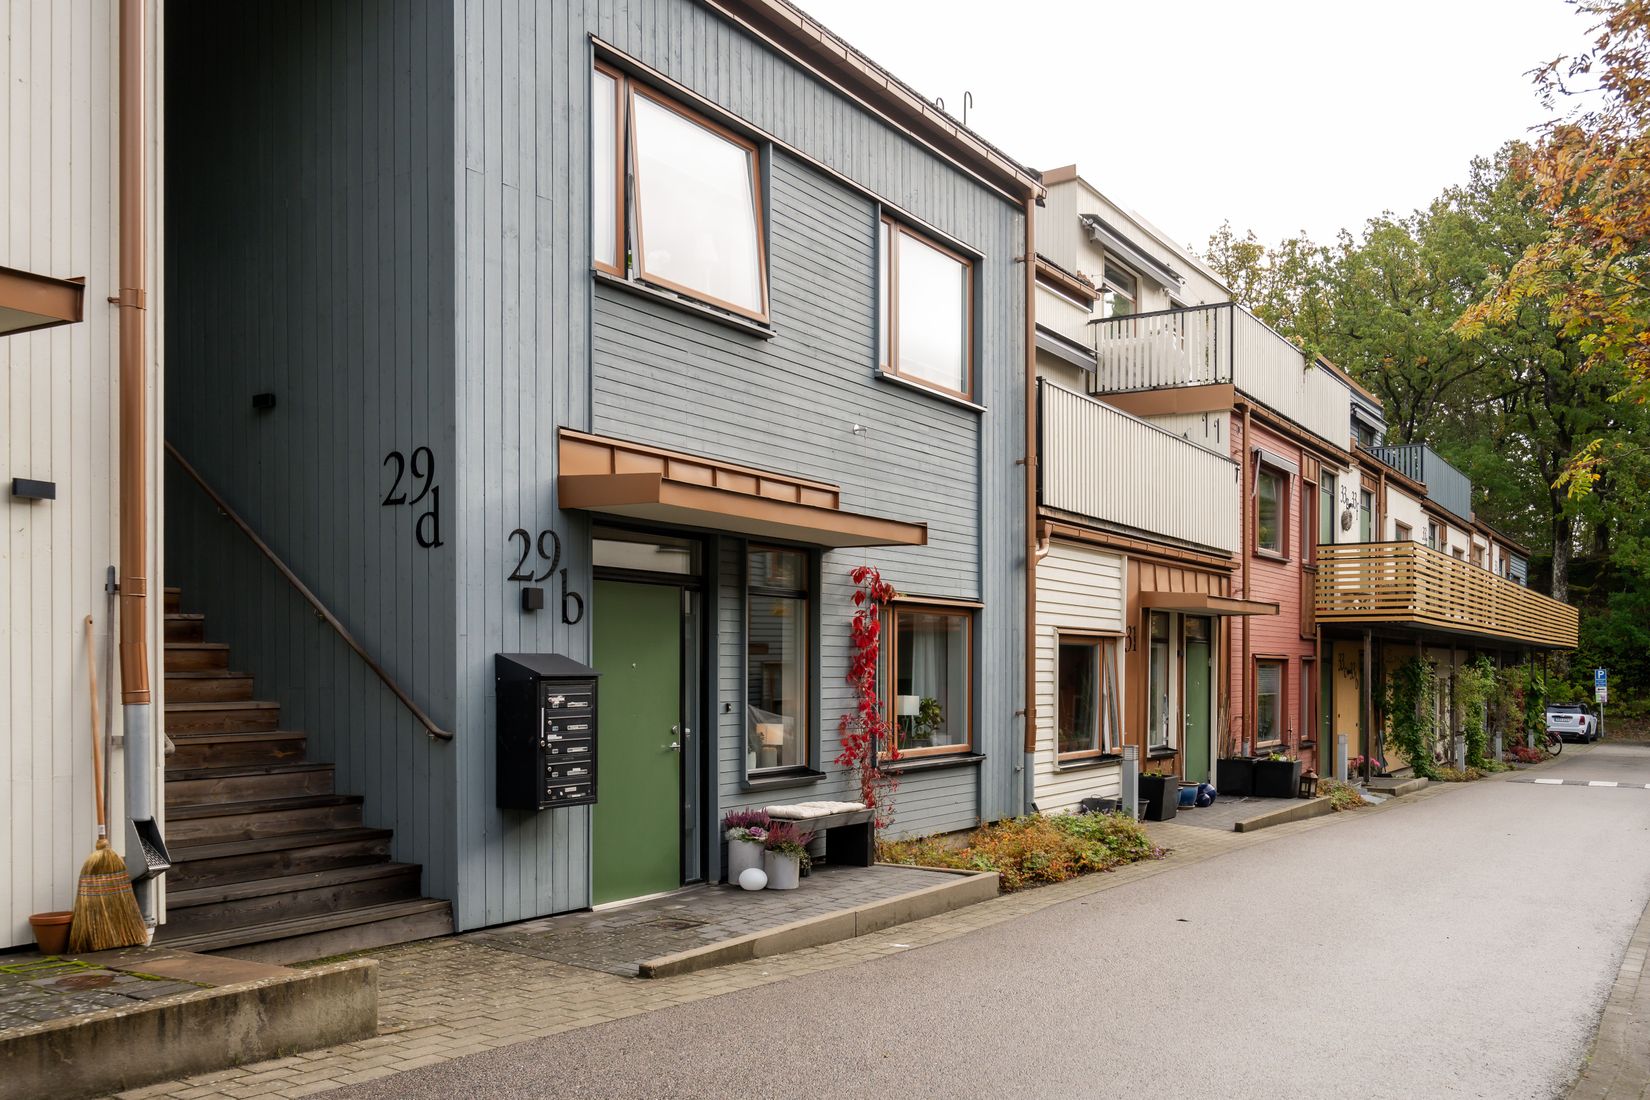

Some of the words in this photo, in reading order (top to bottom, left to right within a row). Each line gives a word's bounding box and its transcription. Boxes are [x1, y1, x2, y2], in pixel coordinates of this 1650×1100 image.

[382, 446, 435, 507] 29
[415, 485, 444, 549] d
[507, 528, 561, 583] 29
[560, 568, 584, 625] b
[1597, 670, 1605, 679] P
